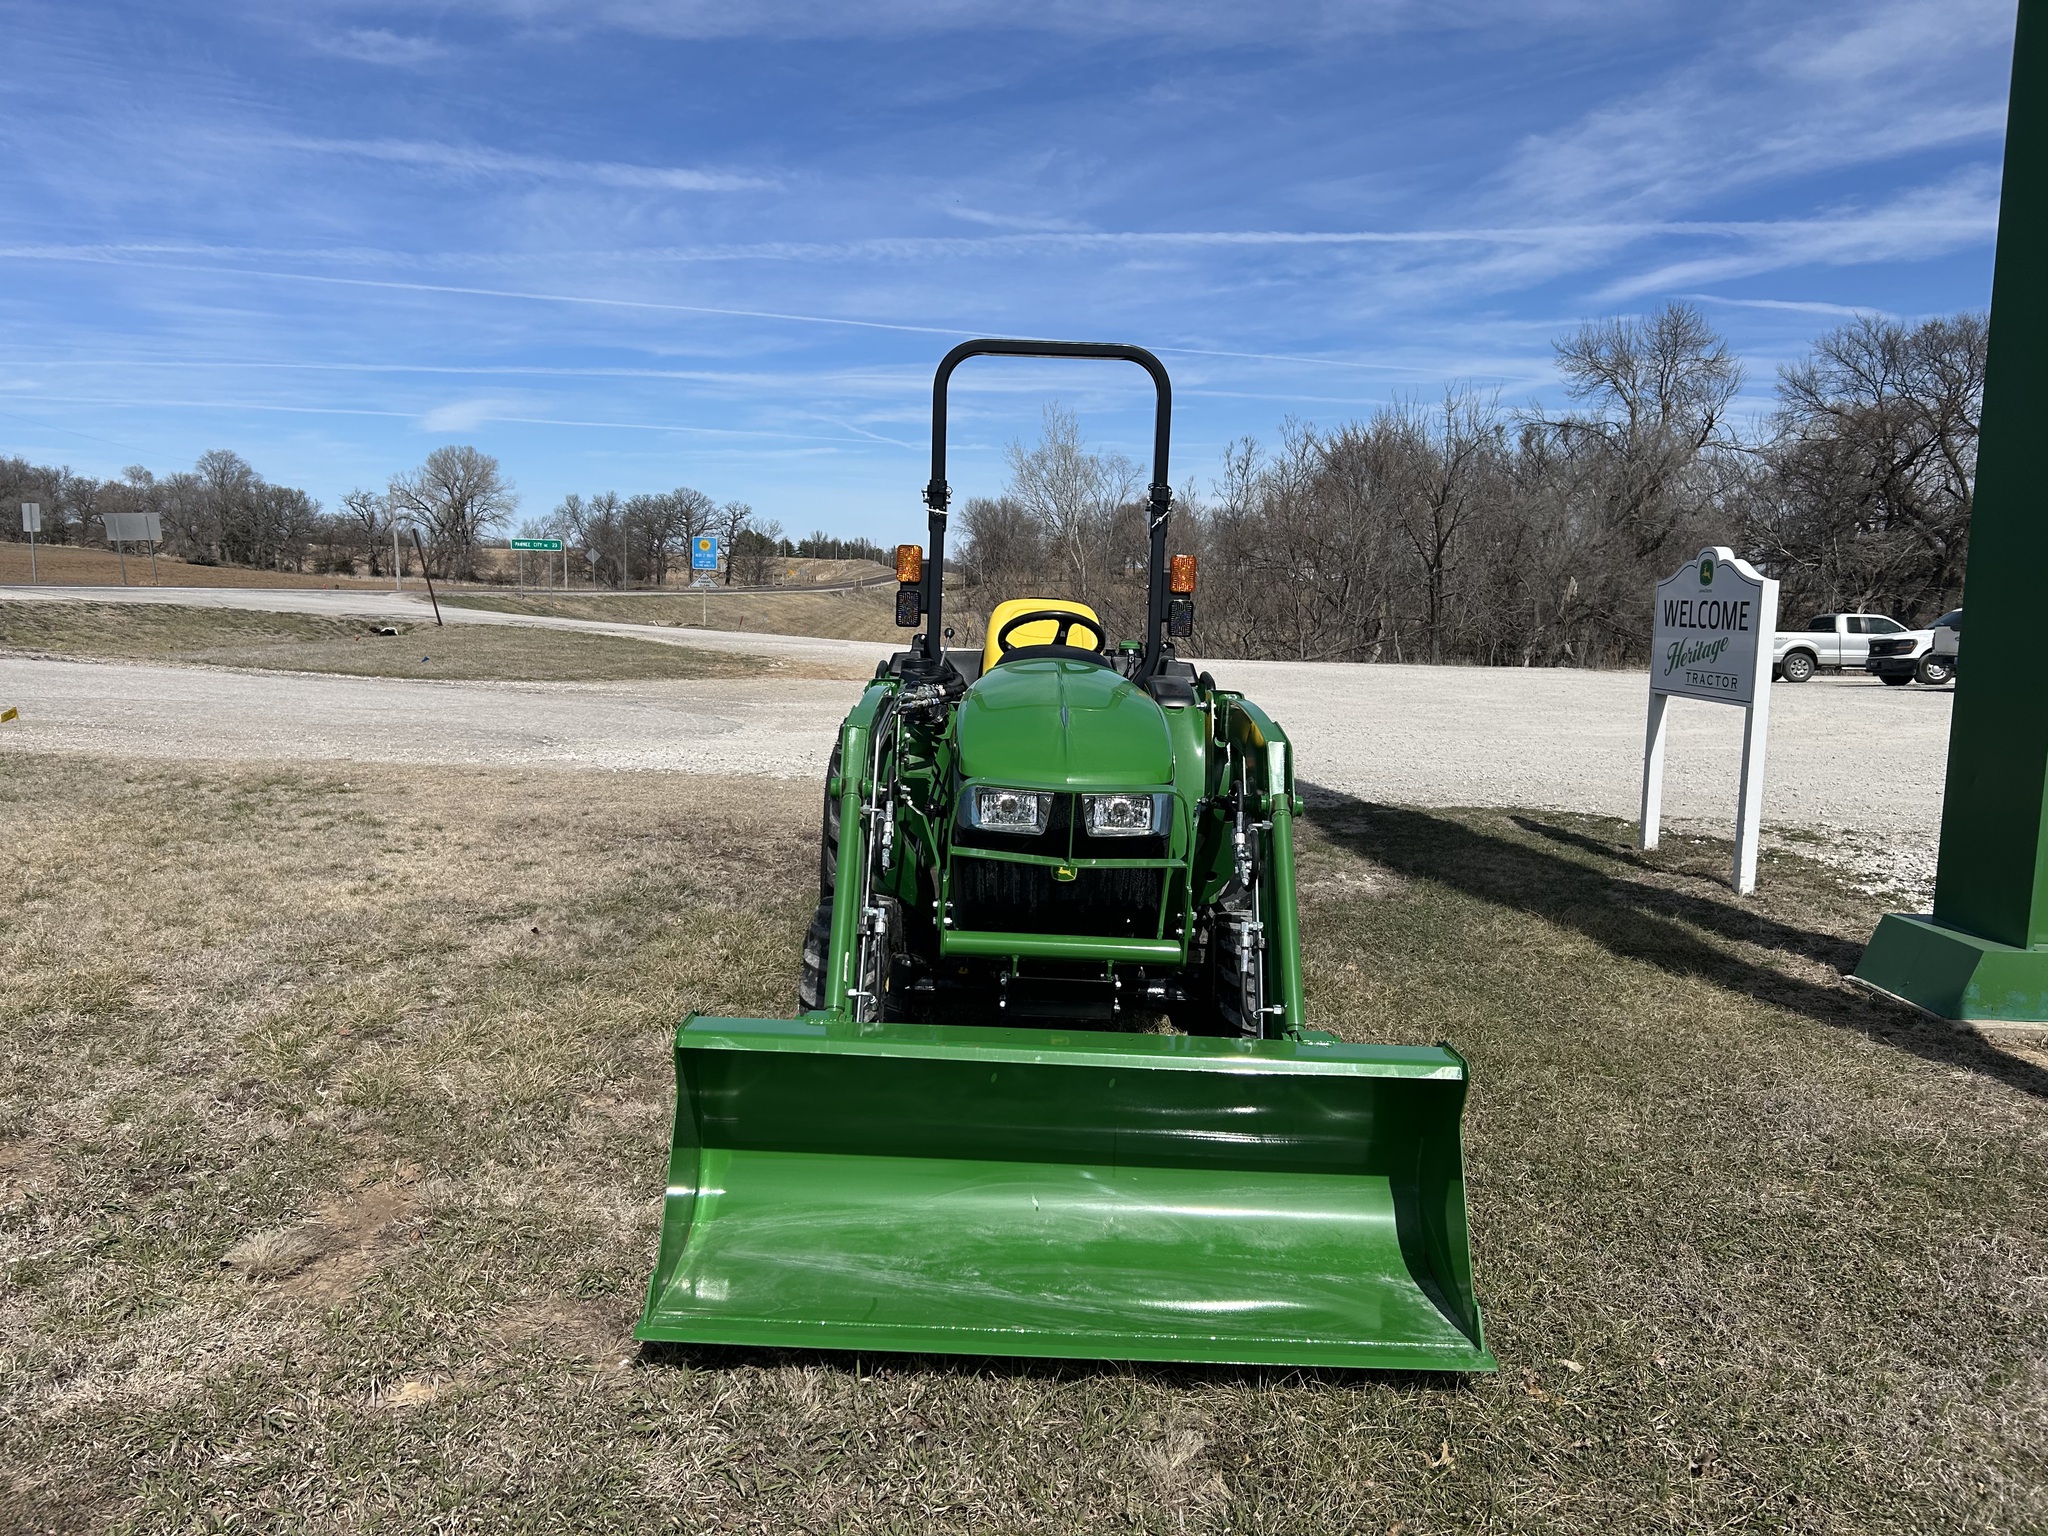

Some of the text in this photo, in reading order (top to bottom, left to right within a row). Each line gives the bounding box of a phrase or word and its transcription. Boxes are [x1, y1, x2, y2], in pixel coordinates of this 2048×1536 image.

[1664, 599, 1750, 631] WELCOME
[1664, 636, 1729, 677] Heritage
[1686, 671, 1738, 689] TRACTOR
